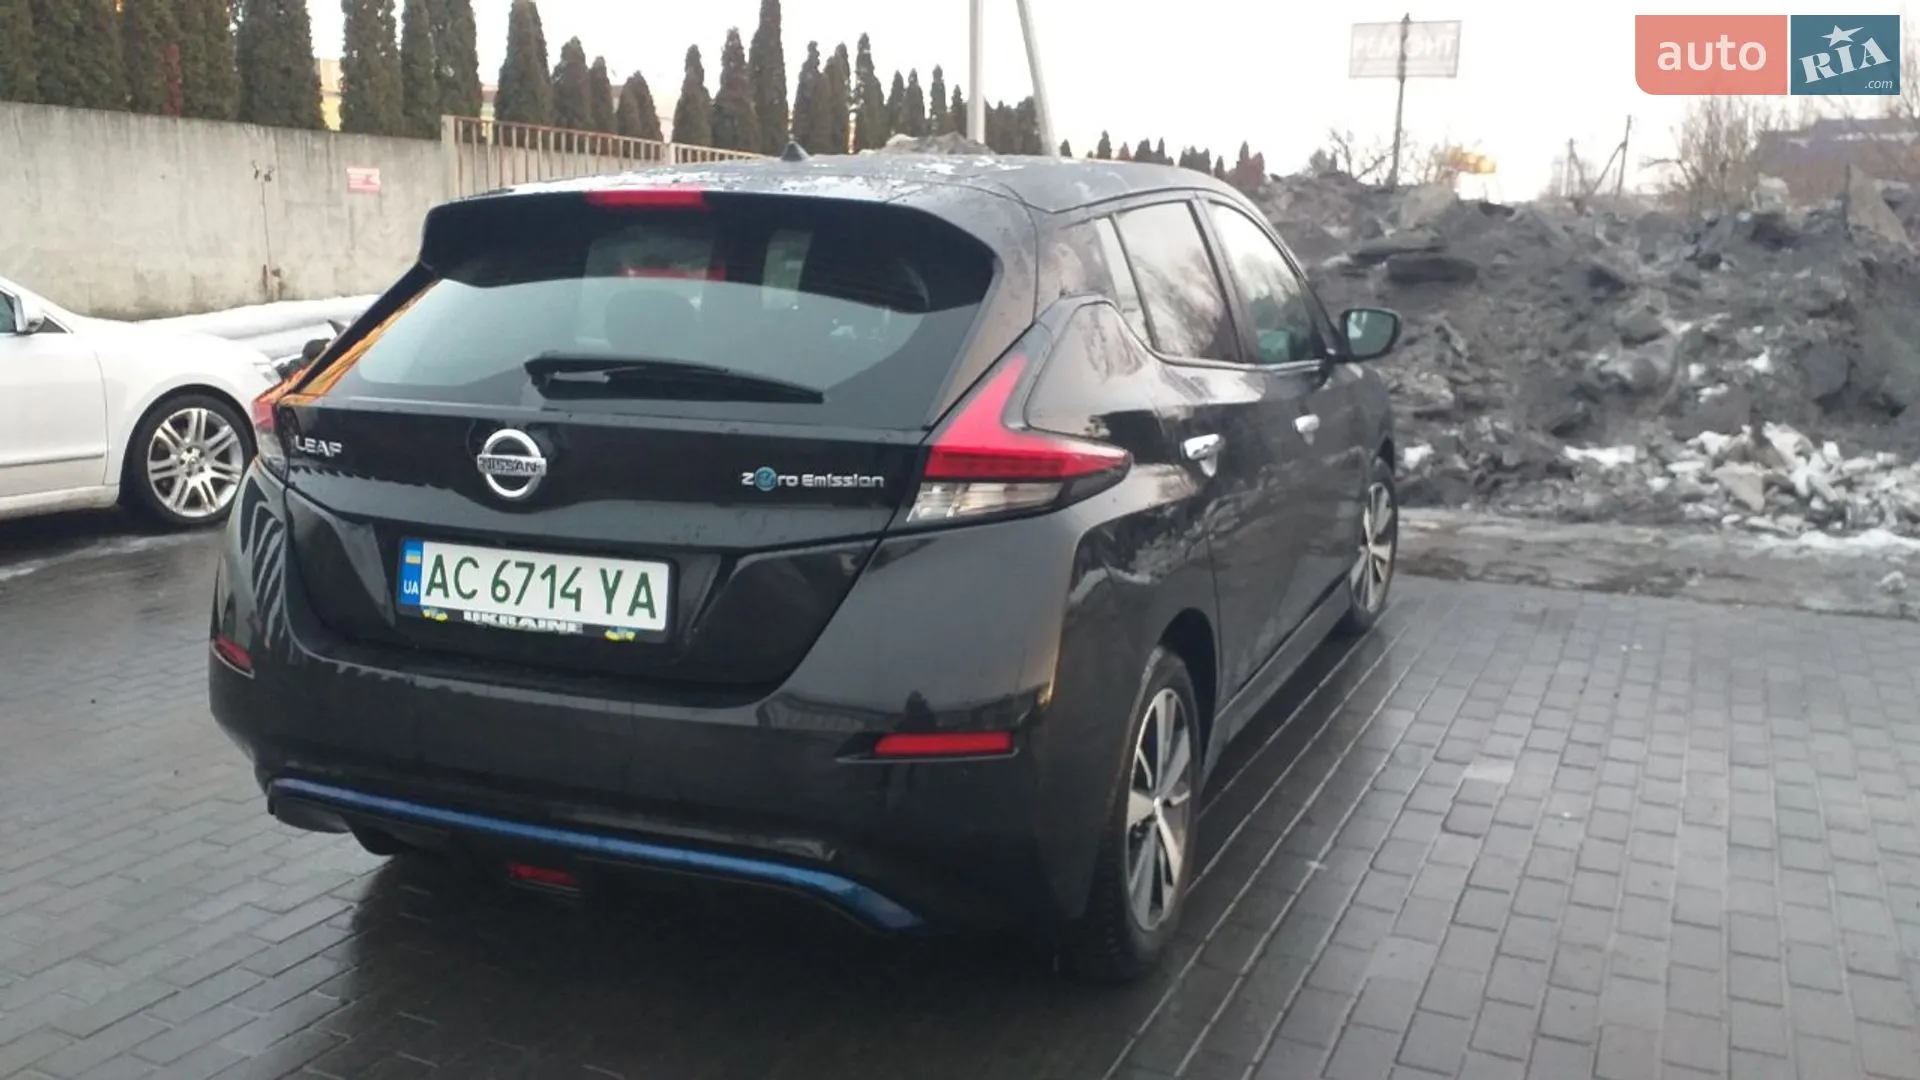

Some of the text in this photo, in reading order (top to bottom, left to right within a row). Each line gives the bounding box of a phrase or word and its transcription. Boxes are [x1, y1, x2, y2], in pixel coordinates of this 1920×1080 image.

[295, 435, 343, 457] LEAF
[480, 457, 538, 473] NISSAN
[802, 473, 885, 488] Emission
[403, 580, 419, 595] UA
[425, 554, 656, 619] AC 6714 YA
[463, 609, 584, 634] UKRAINE
